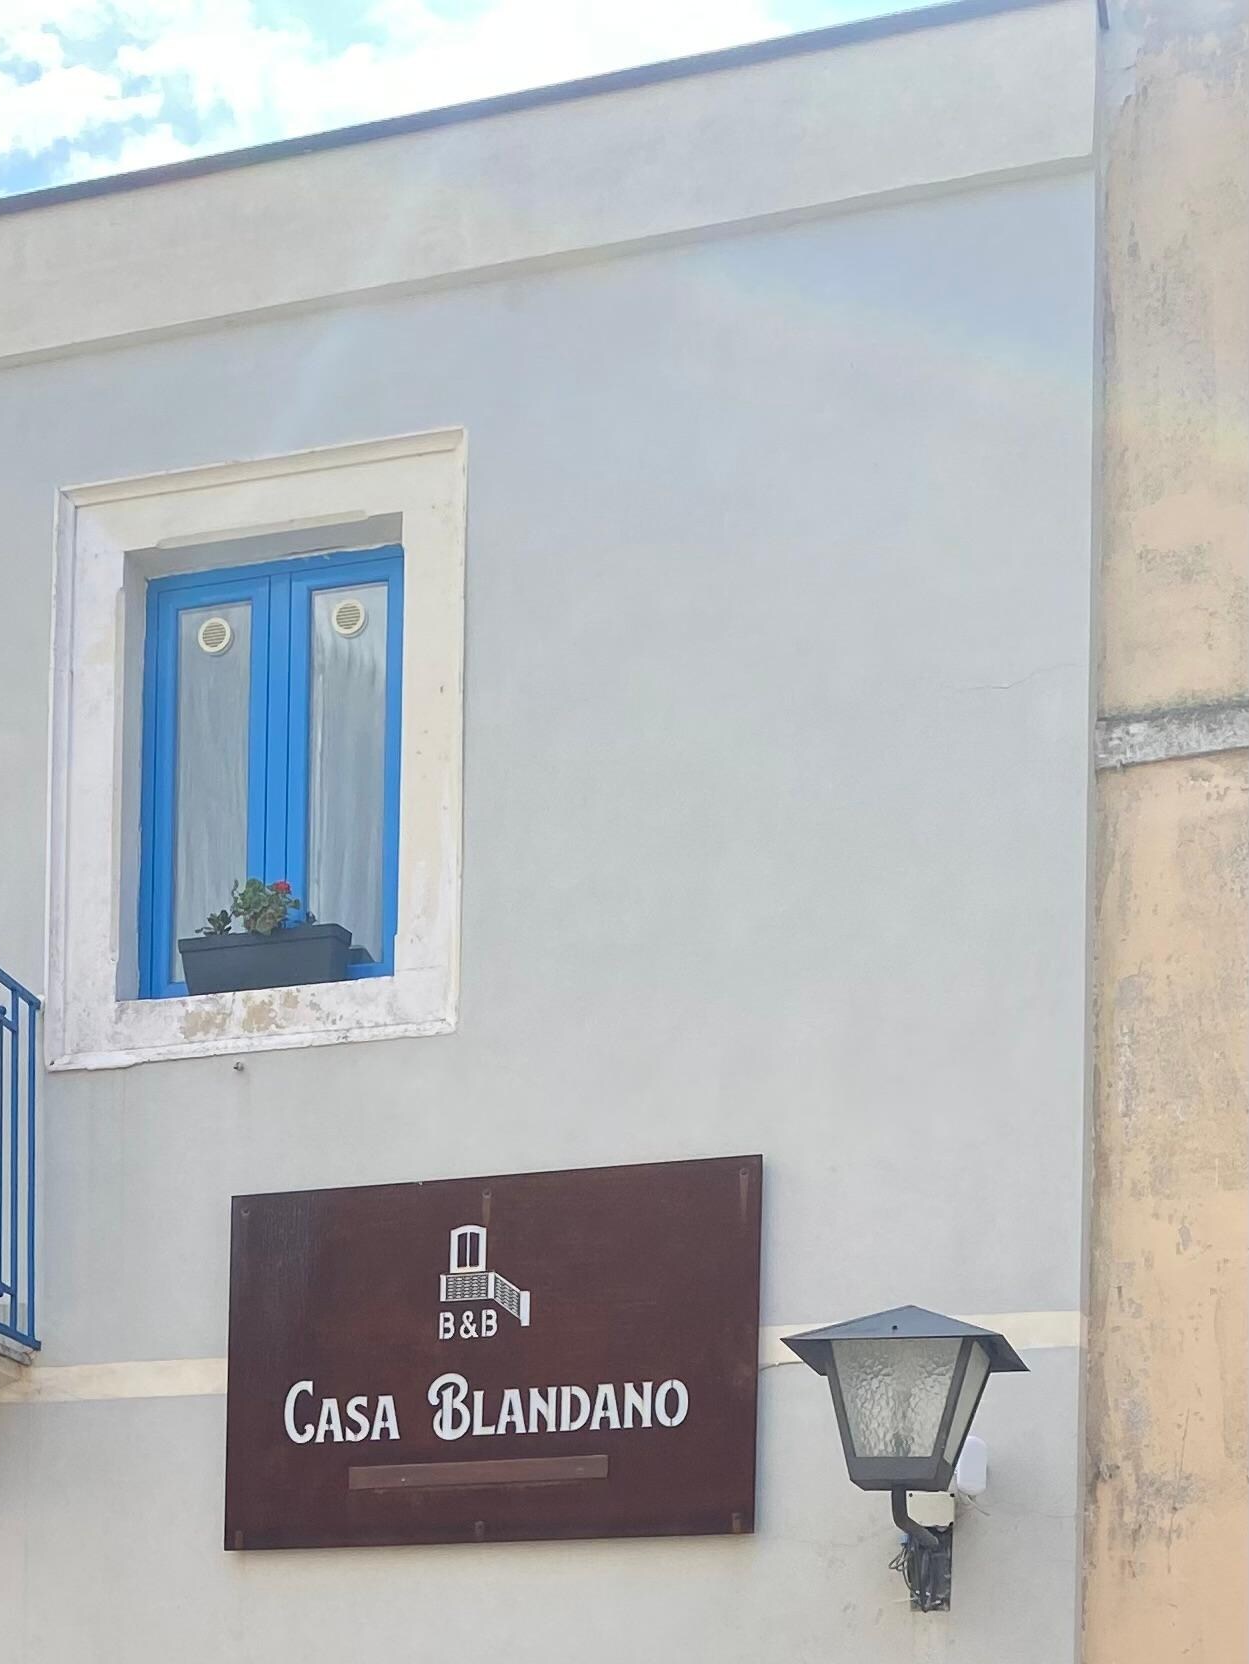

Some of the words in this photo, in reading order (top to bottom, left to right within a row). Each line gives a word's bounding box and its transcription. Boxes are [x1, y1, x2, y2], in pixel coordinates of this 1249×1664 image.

[439, 1309, 498, 1340] B&B
[284, 1380, 401, 1444] CASA
[428, 1372, 689, 1441] BLANDANO
